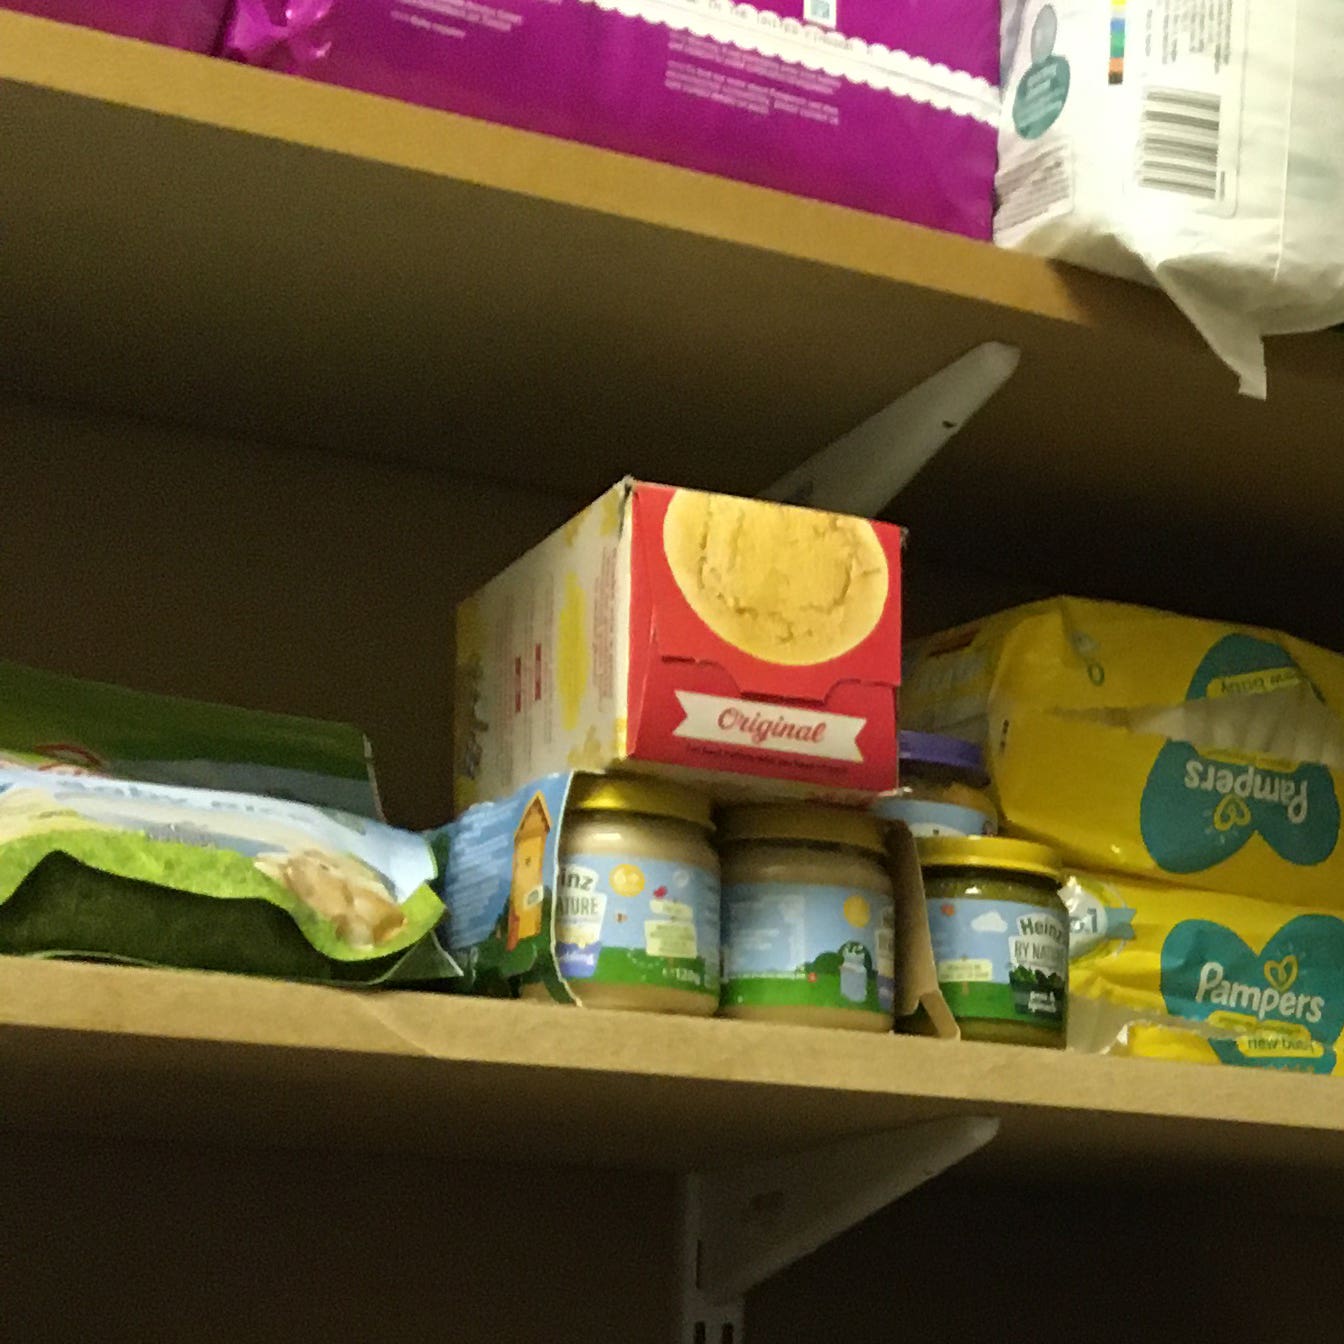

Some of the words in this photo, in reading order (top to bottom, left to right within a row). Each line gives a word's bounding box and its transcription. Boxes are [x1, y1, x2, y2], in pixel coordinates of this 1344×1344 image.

[716, 706, 827, 745] Original
[1183, 758, 1310, 824] Pampers
[1195, 961, 1325, 1024] Pampers
